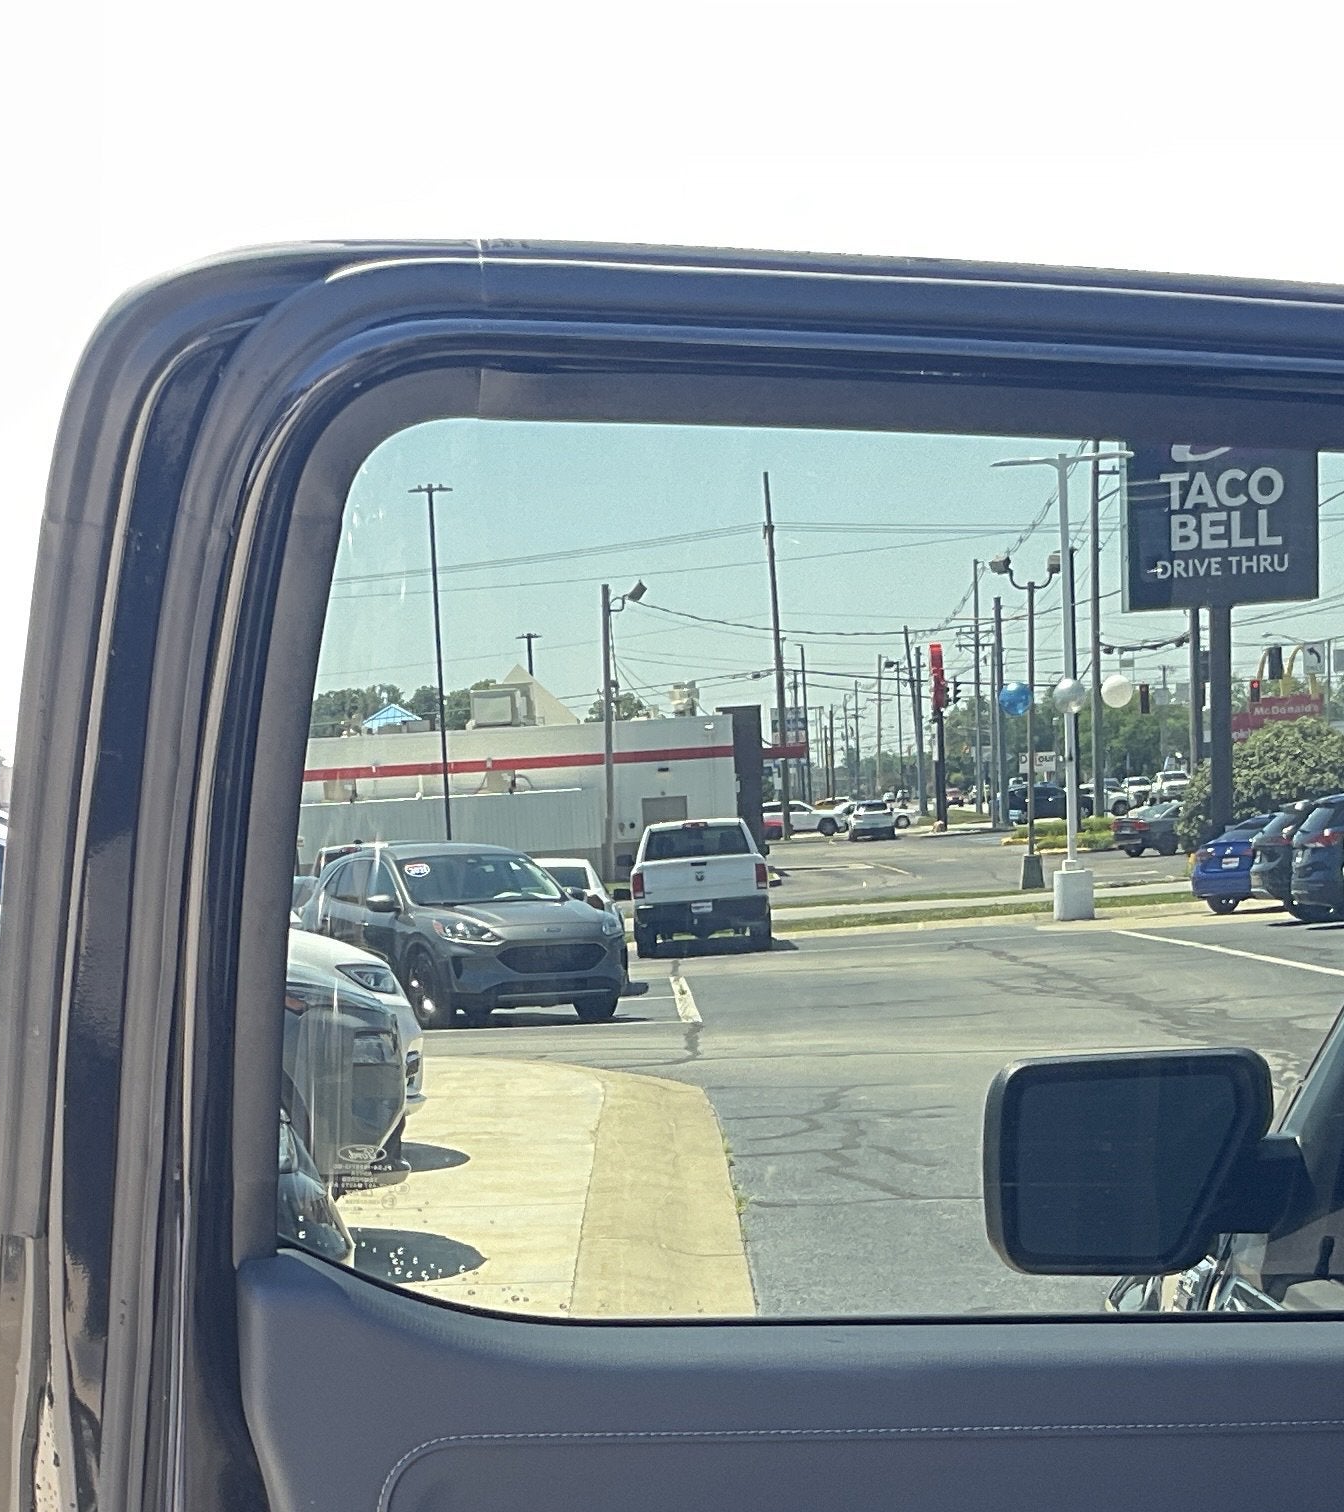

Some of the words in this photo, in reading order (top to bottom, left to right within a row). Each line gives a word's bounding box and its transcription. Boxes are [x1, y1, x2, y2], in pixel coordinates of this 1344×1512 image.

[1159, 466, 1285, 511] TACO
[1170, 509, 1284, 551] BELL
[1157, 557, 1222, 579] DRIVE
[1228, 553, 1289, 575] THRU
